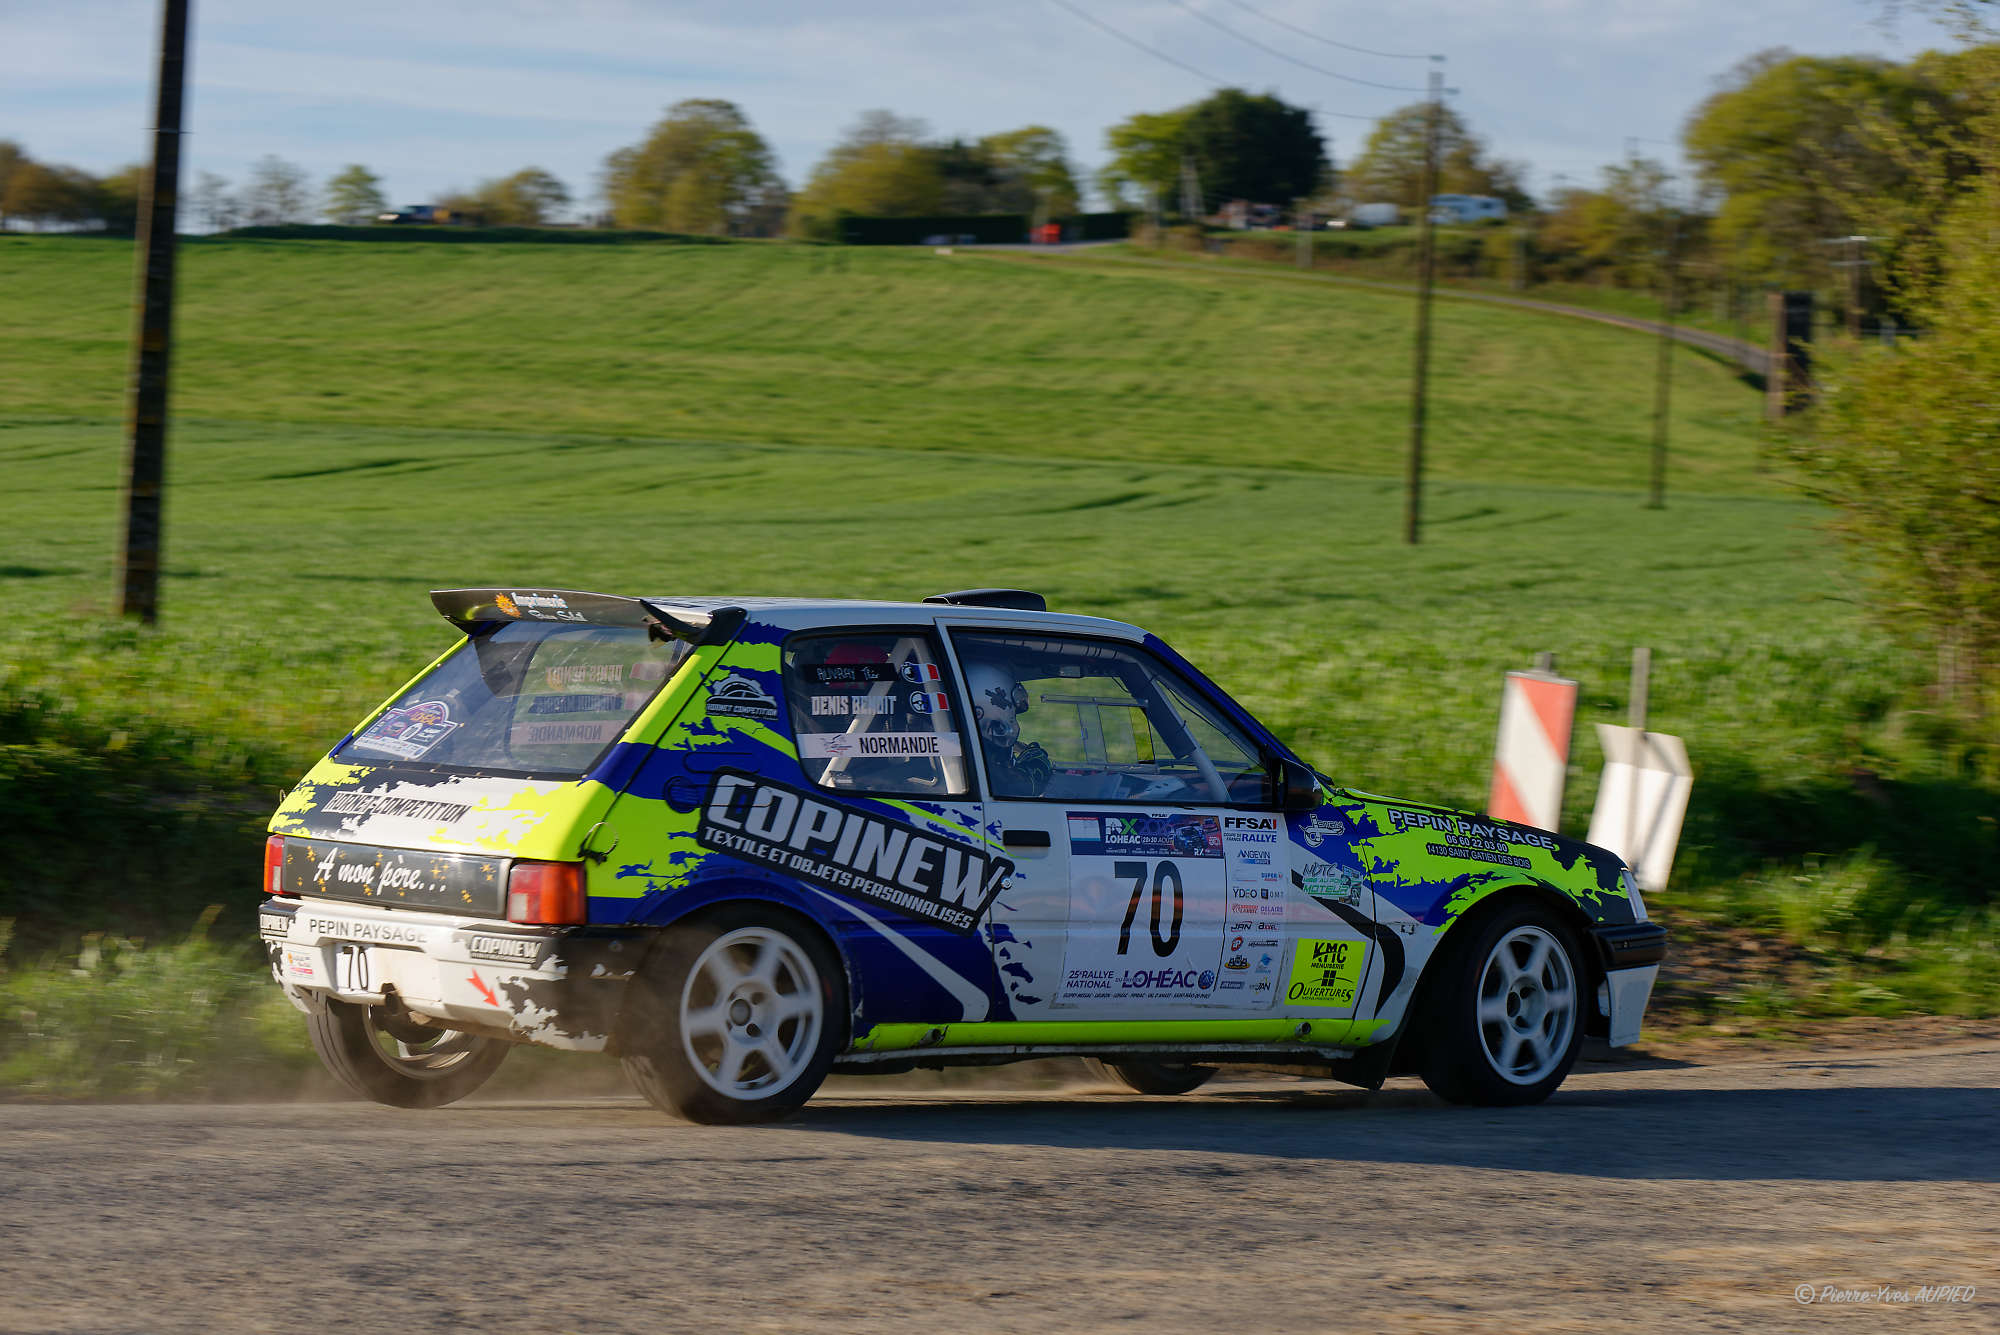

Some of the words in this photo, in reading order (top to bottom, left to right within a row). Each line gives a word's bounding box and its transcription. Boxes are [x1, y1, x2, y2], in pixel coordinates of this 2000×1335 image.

[811, 695, 850, 716] DENIS
[859, 736, 939, 754] NORMANDIE
[1105, 817, 1138, 835] RX
[1224, 816, 1273, 830] FFSA
[1387, 808, 1454, 832] PEPIN
[1457, 820, 1556, 850] PAYSAGE
[706, 774, 1006, 912] COPINEW
[1105, 835, 1141, 844] LOHEAC
[1242, 833, 1277, 843] RALLYE
[1445, 833, 1459, 844] 06
[1459, 836, 1471, 846] 60
[1471, 838, 1484, 849] 22
[1484, 839, 1496, 851] 03
[1496, 841, 1509, 853] 00
[312, 847, 341, 882] A
[338, 861, 376, 886] mon
[1426, 844, 1448, 857] 14130
[1448, 847, 1471, 860] SAINT
[1471, 850, 1498, 863] GATIEN
[1497, 853, 1513, 865] DES
[1513, 856, 1532, 869] BOIS
[703, 826, 770, 859] TEXTILE
[768, 846, 788, 865] ET
[789, 853, 852, 887] OBJETS
[853, 874, 975, 930] PERSONNALISÉS
[1114, 860, 1184, 957] 70
[309, 918, 349, 937] PEPIN
[471, 936, 543, 958] COPINEW
[342, 945, 369, 992] 70
[1080, 970, 1114, 979] RALLYE
[1121, 967, 1197, 989] LOHÉAC
[1066, 980, 1112, 989] NATIONAL
[1289, 982, 1355, 1003] OUVERTURES
